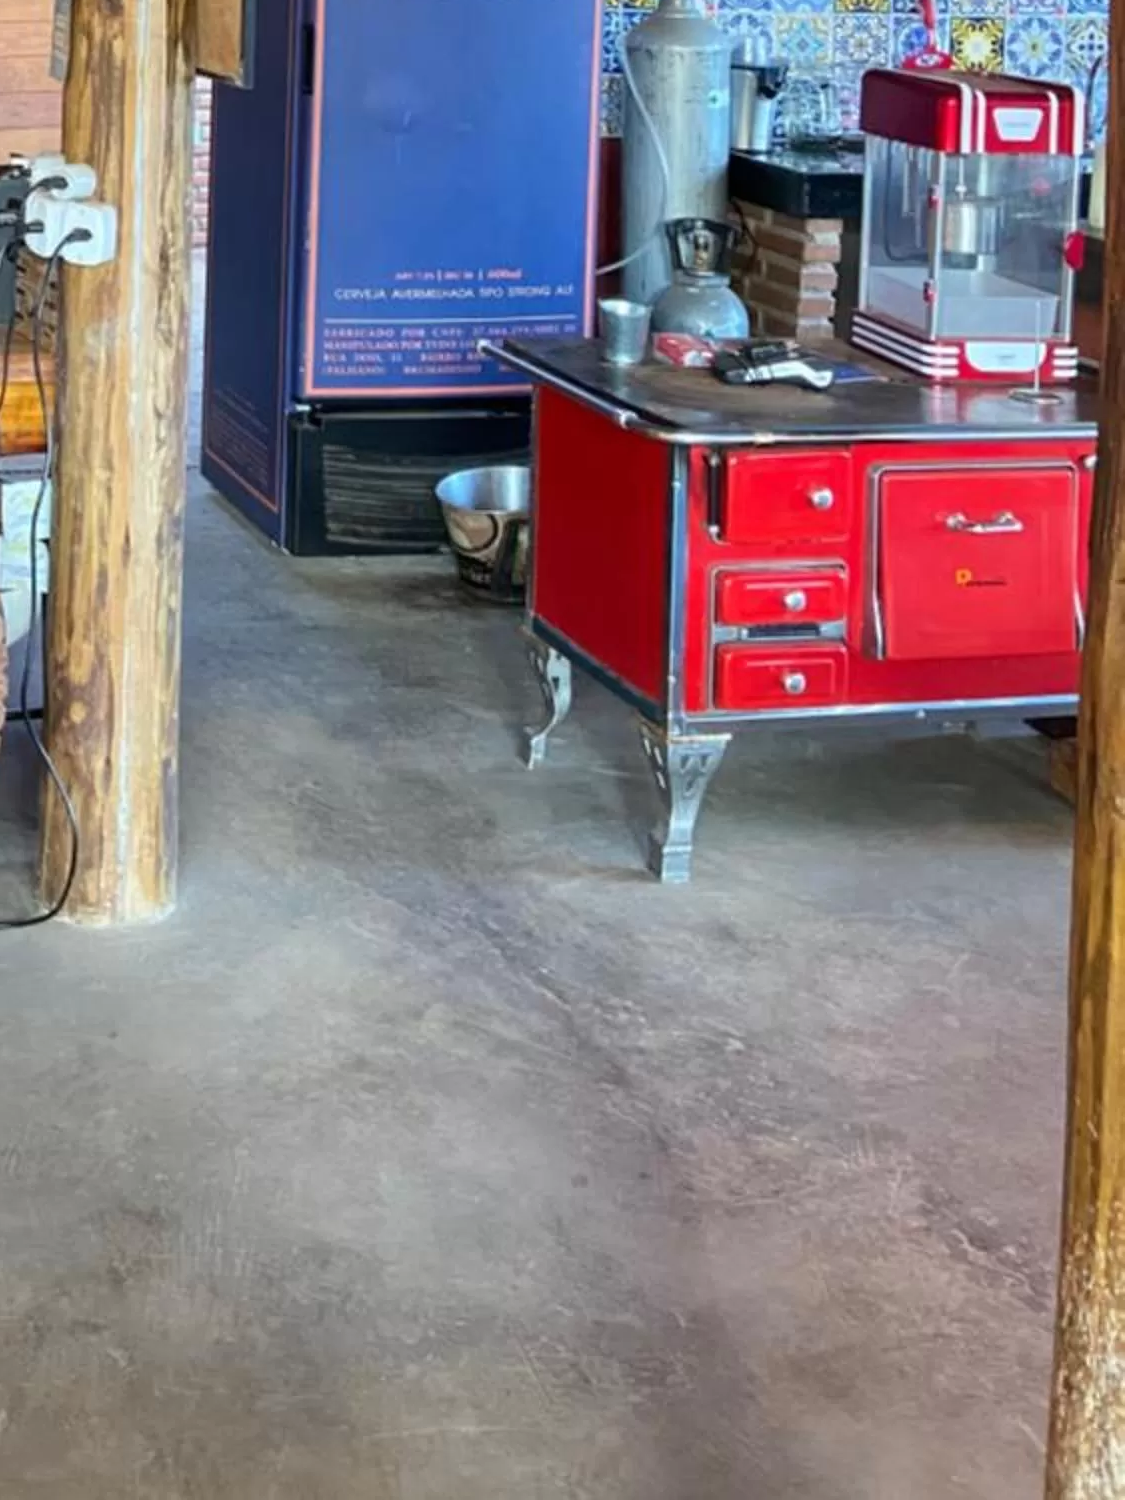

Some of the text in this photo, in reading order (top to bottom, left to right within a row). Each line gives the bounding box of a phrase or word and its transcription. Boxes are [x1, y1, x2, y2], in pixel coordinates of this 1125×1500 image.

[334, 287, 387, 300] CERVEJA
[391, 287, 476, 300] AVERMELHADA
[508, 284, 550, 298] STRONG
[555, 283, 574, 296] ALE
